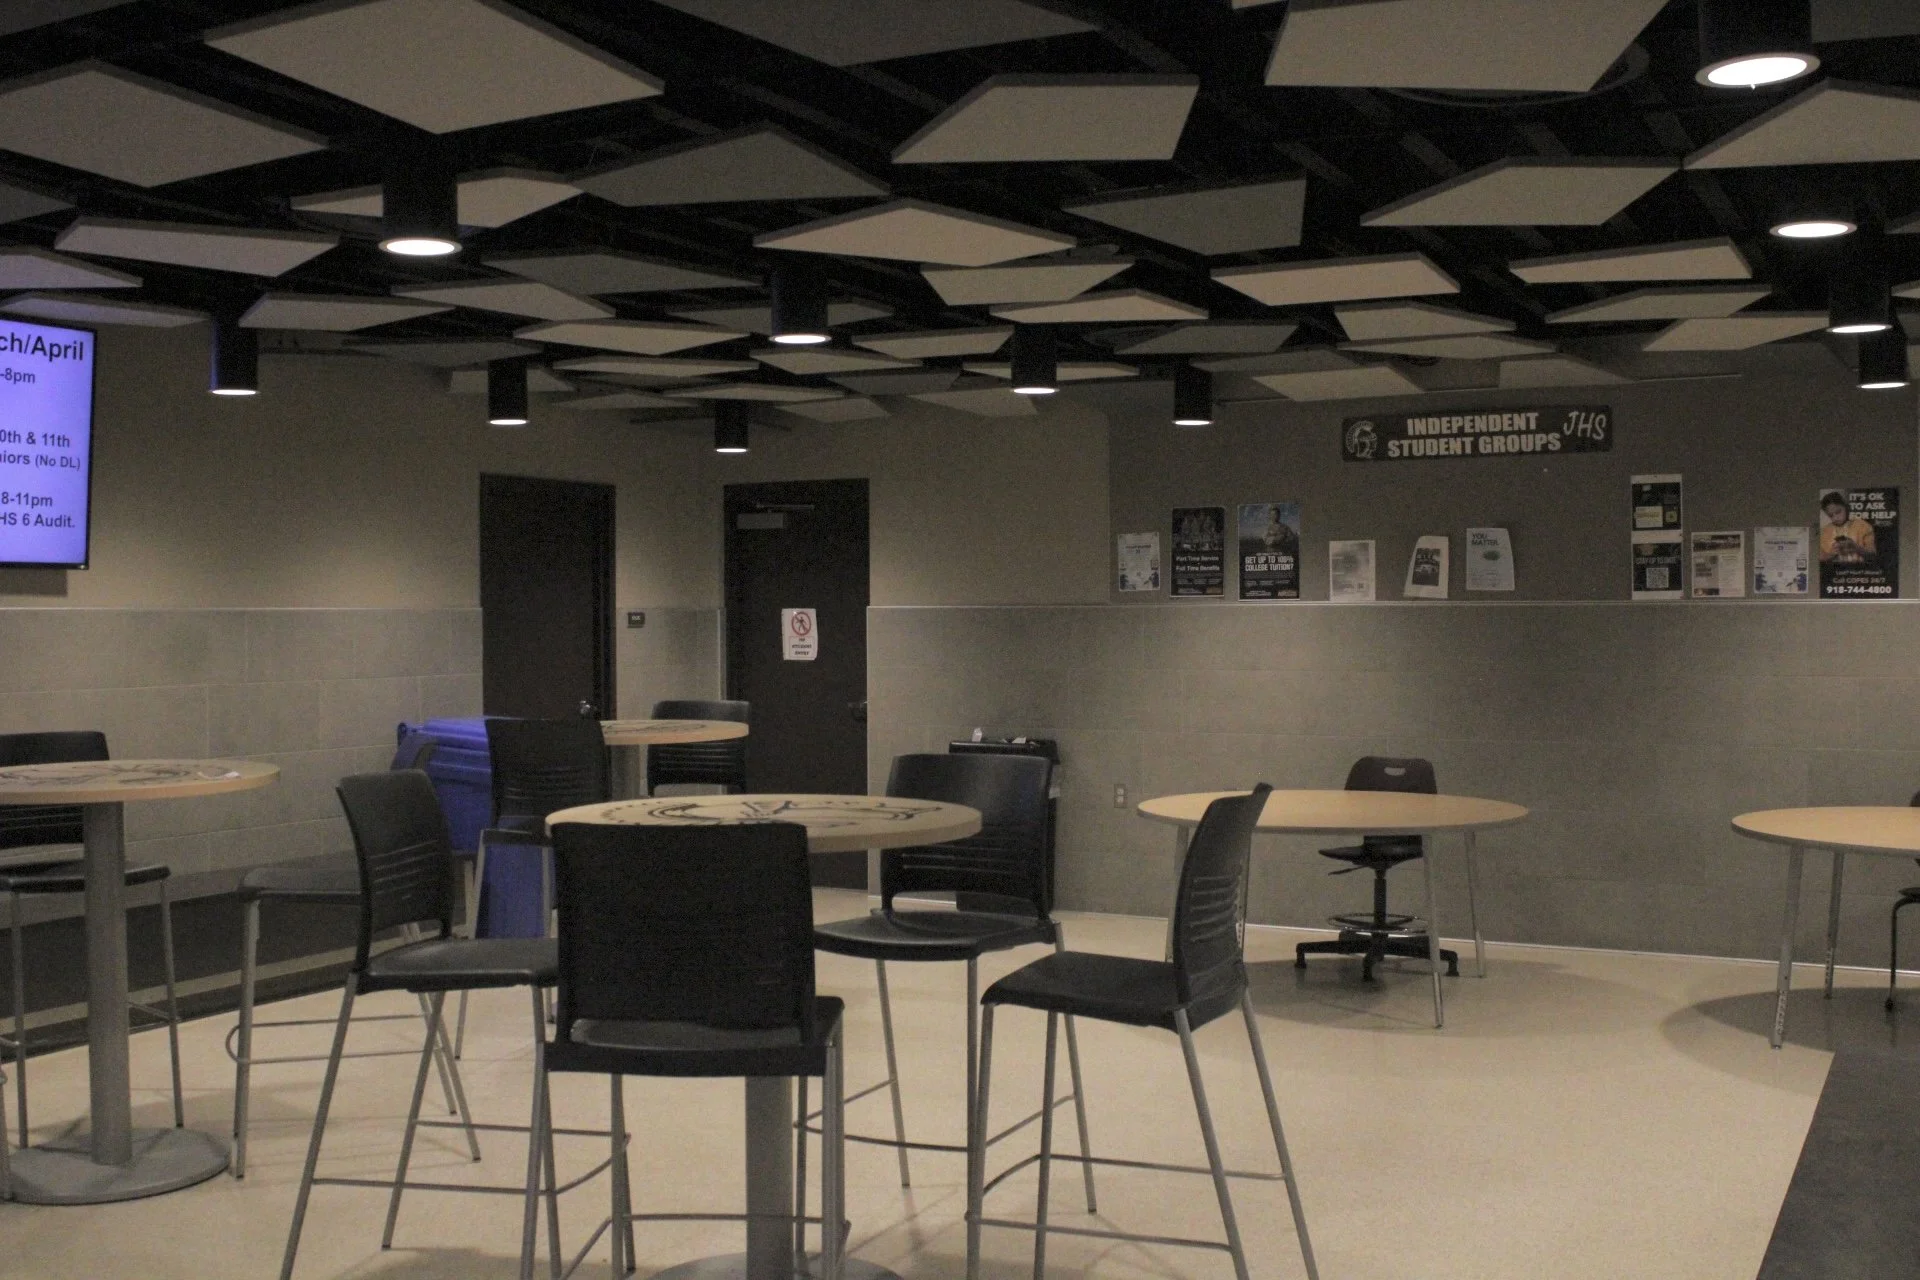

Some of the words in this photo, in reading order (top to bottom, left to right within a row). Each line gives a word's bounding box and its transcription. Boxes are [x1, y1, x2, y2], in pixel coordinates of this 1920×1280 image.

[1407, 412, 1539, 436] INDEPENDENT
[1563, 410, 1607, 440] JHS
[26, 431, 36, 445] &
[42, 433, 70, 448] 11th
[1388, 437, 1474, 458] STUDENT
[1478, 432, 1561, 453] GROUPS
[0, 450, 30, 465] iors
[35, 454, 56, 468] (No
[60, 456, 81, 471] DL)
[1, 491, 53, 509] 8-11pm
[1868, 492, 1884, 501] OK
[1849, 502, 1863, 510] TO
[1865, 502, 1886, 510] ASK
[22, 513, 30, 526] 6
[34, 513, 75, 528] Audit.
[1849, 511, 1869, 520] FOR
[1871, 511, 1896, 519] HELP
[1245, 556, 1256, 564] GET
[1257, 555, 1266, 563] UP
[1268, 555, 1276, 563] TO
[1245, 564, 1269, 572] COLLEGE
[1826, 586, 1892, 594] 918-744-4800
